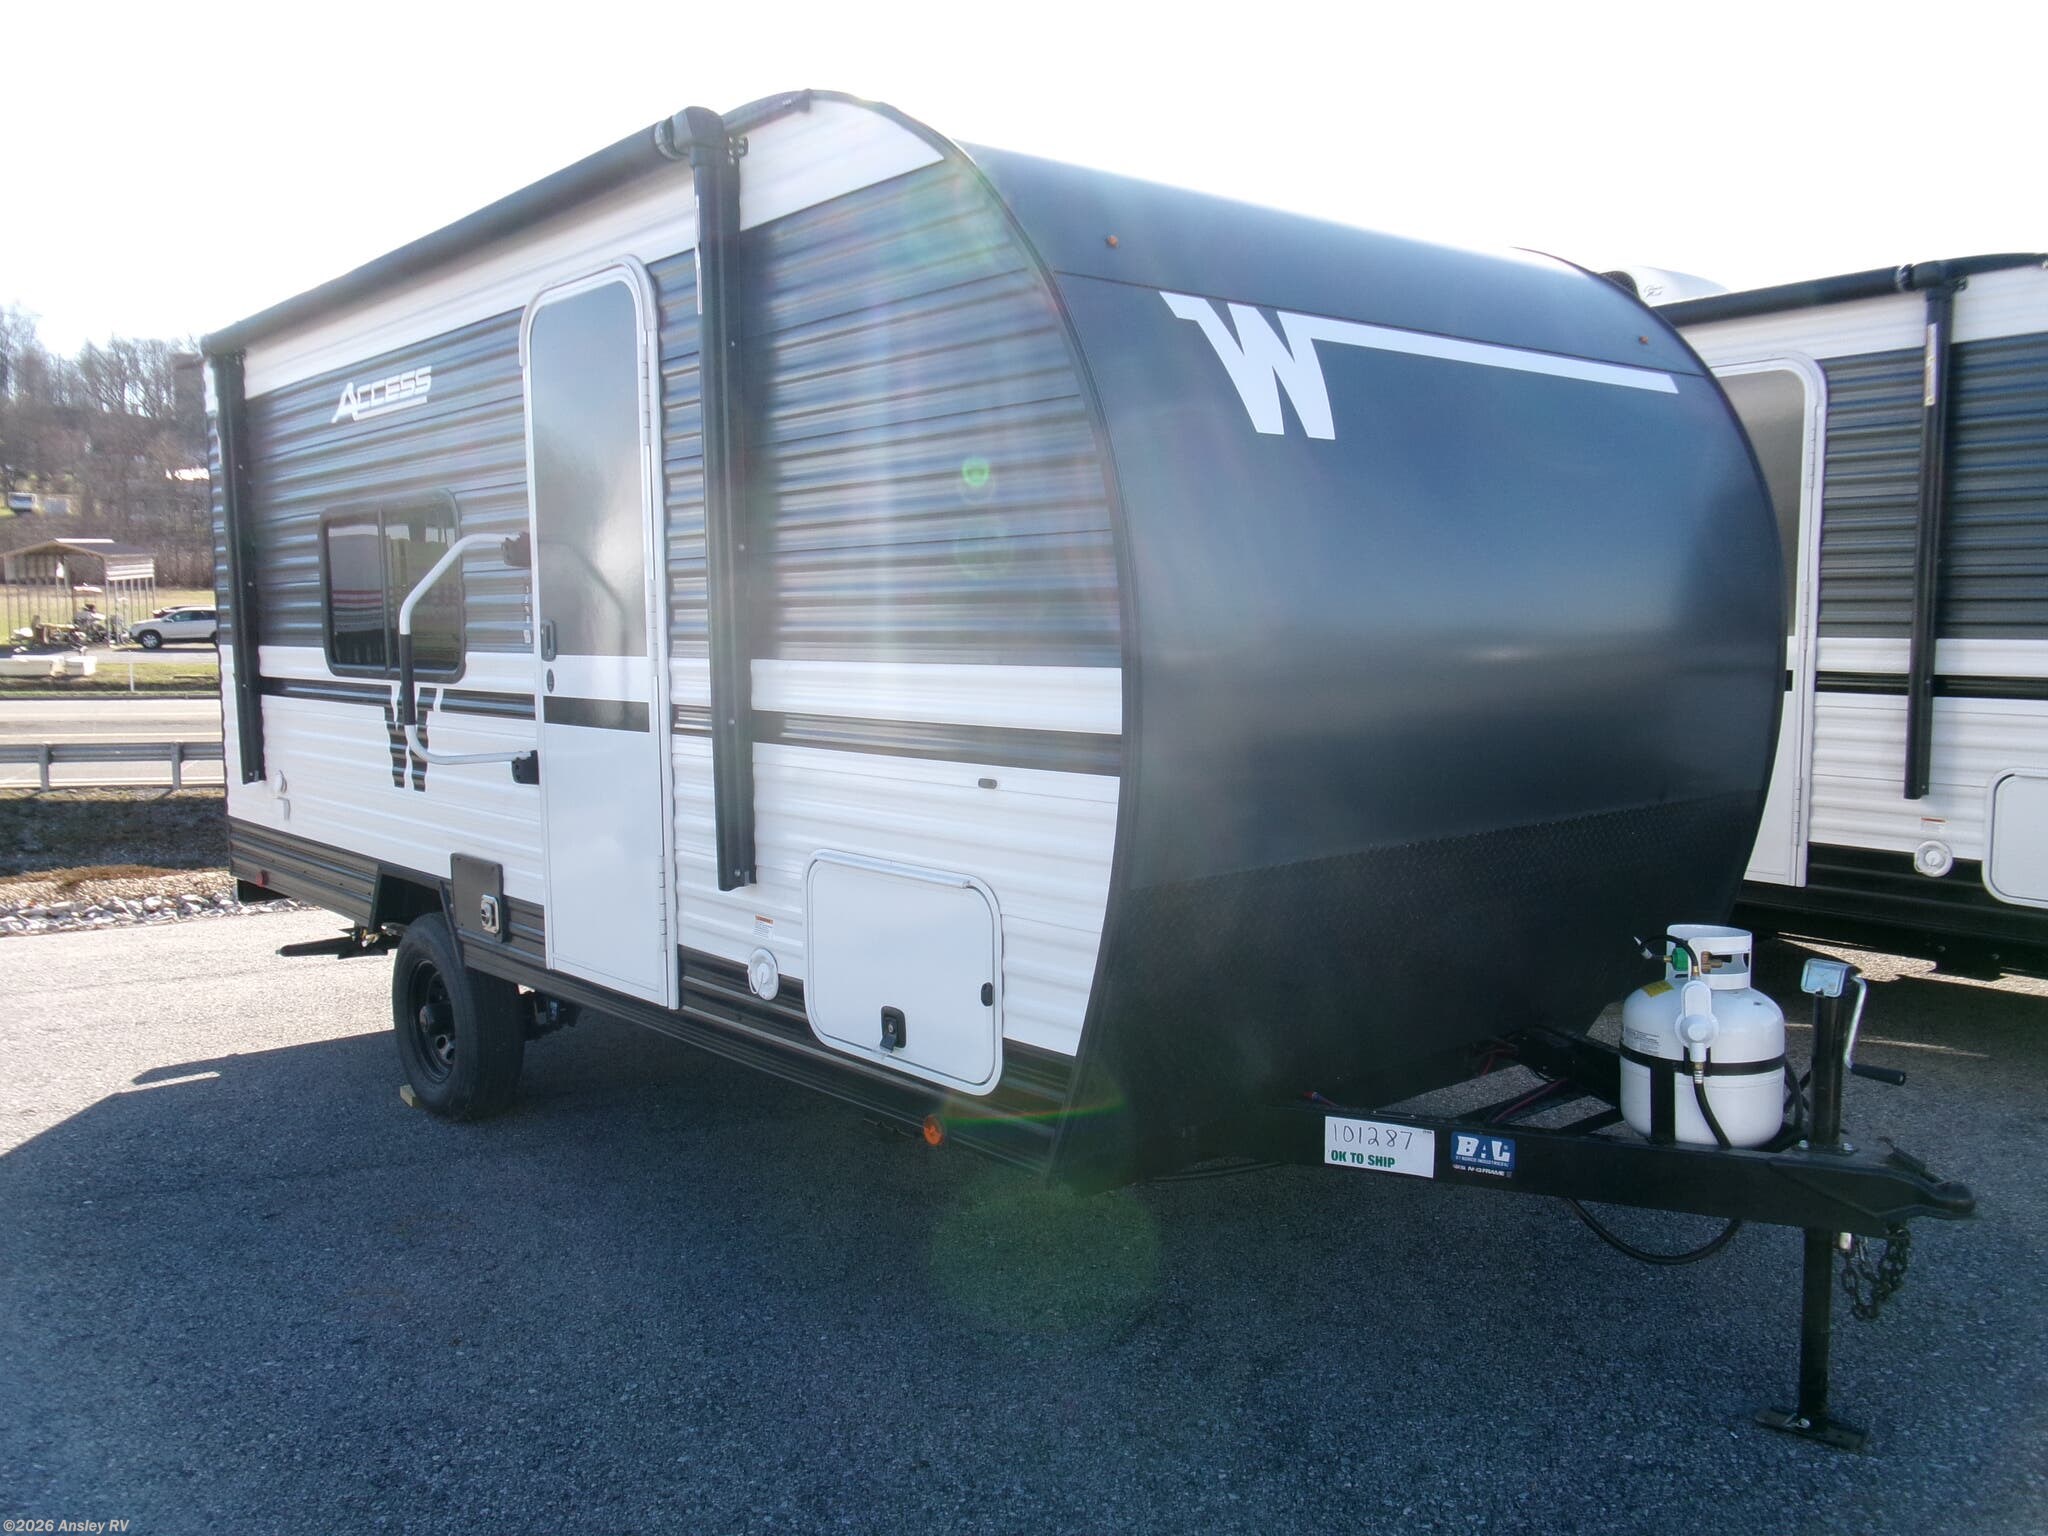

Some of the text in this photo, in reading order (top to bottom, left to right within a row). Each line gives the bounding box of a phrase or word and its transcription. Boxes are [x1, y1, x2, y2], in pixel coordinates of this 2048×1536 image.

[331, 366, 432, 423] ACCESS
[1333, 1123, 1413, 1150] 101287
[1331, 1150, 1396, 1169] OK TO SHIP
